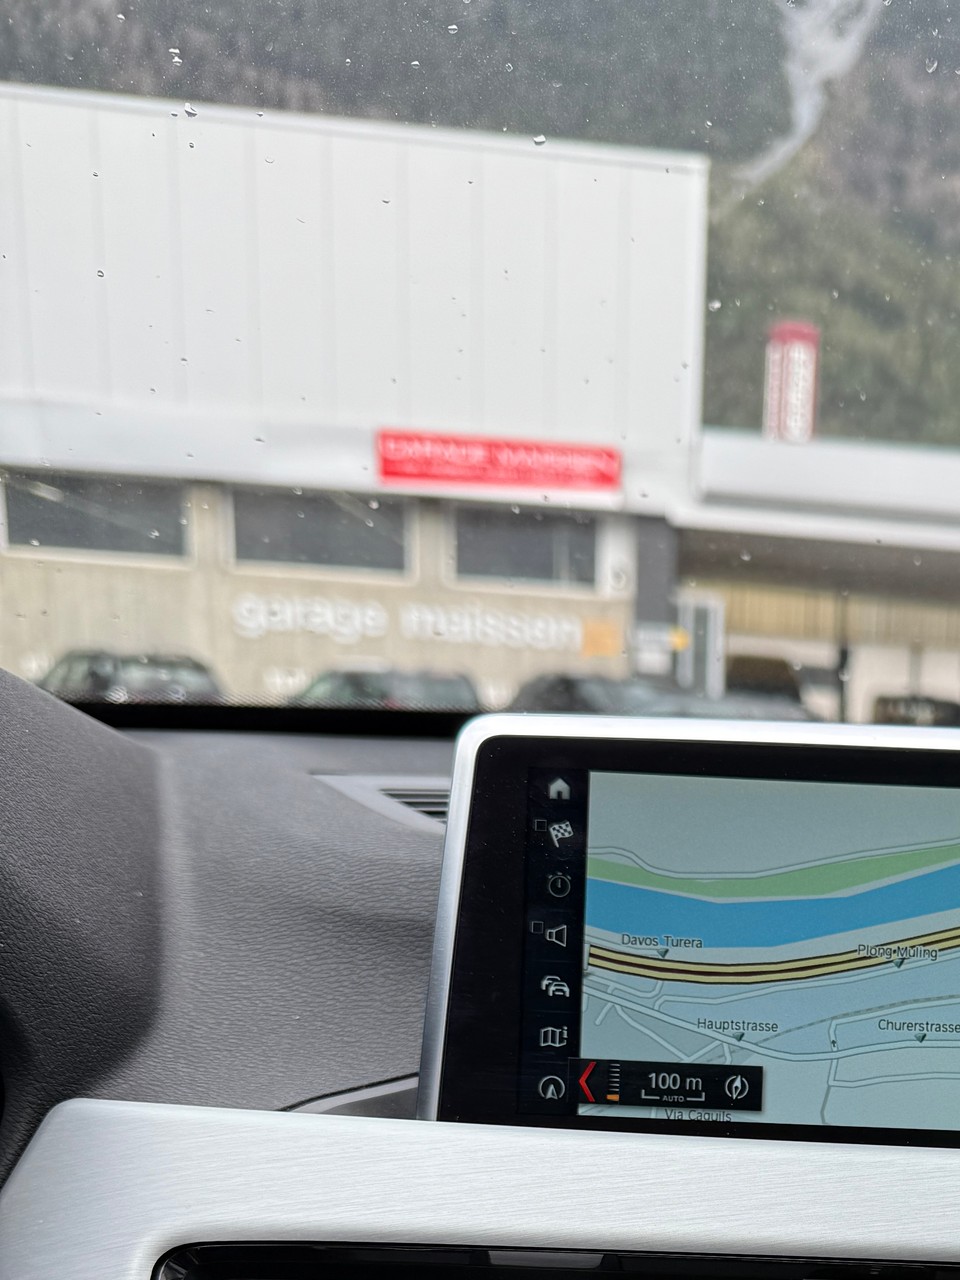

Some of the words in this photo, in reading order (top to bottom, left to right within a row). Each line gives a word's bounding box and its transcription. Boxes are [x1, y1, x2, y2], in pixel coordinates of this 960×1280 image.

[621, 933, 659, 946] Davos
[664, 935, 703, 948] Turera
[857, 944, 893, 959] Plong
[697, 1018, 778, 1032] Hauptstrasse
[648, 1072, 681, 1090] 100
[685, 1077, 703, 1091] m
[662, 1095, 685, 1103] AUTO
[664, 1108, 684, 1121] Via
